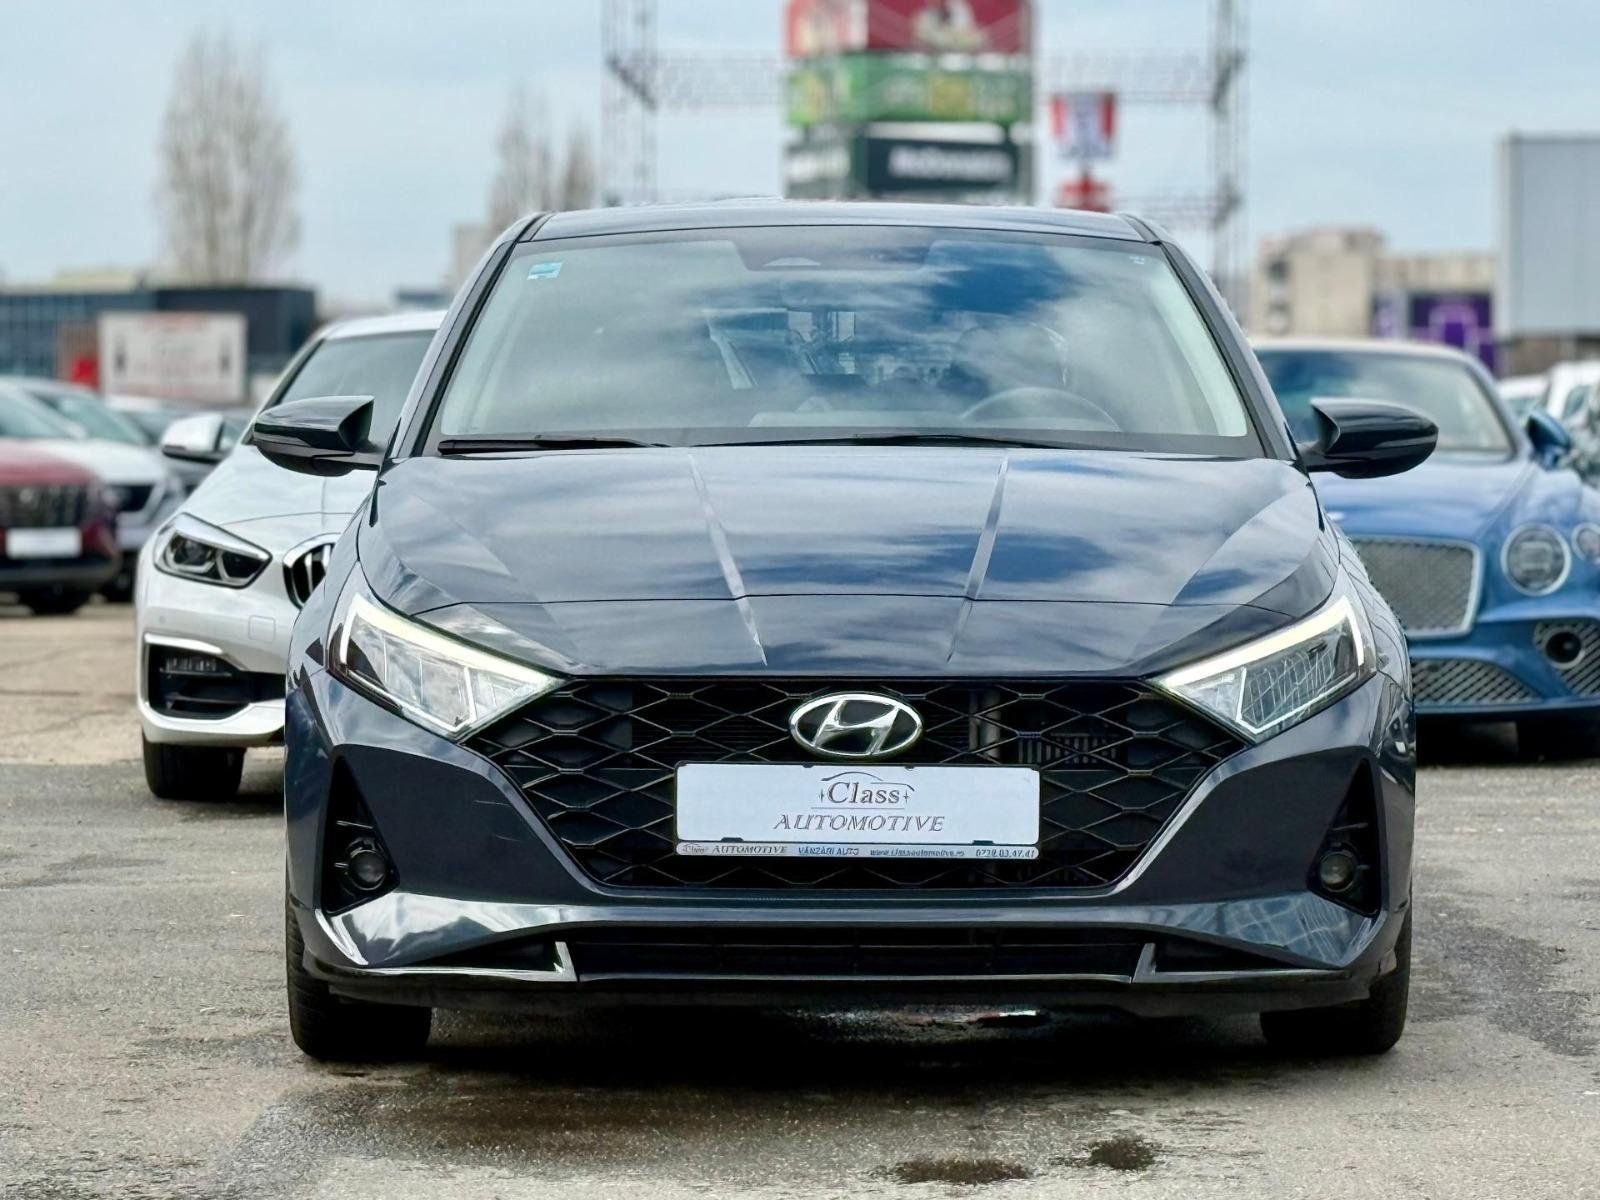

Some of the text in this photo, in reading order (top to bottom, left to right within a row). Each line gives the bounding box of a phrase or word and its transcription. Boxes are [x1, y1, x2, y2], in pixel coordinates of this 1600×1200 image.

[827, 781, 900, 804] Class
[774, 814, 945, 832] AUTOMOTIVE
[712, 845, 787, 854] AUTOMOTIVE
[836, 847, 859, 856] AUTO
